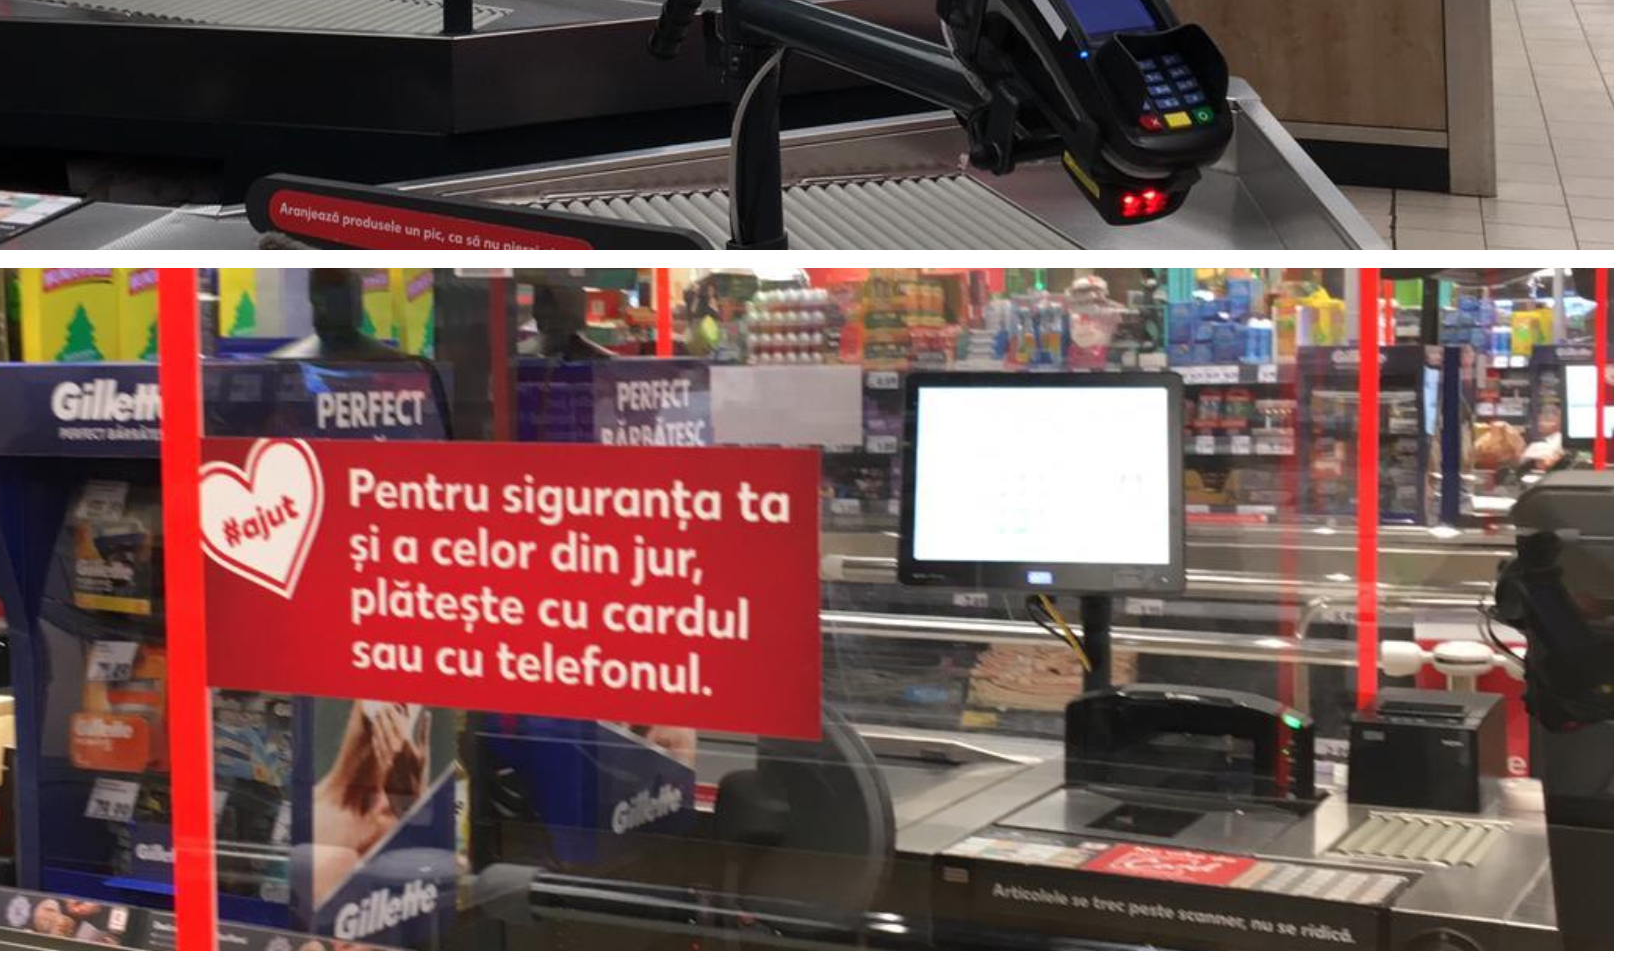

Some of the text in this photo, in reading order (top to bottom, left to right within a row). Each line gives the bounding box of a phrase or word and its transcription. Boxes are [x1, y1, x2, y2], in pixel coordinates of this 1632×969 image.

[279, 201, 341, 226] Aranjează
[342, 214, 403, 235] produsele
[405, 224, 421, 237] un
[423, 226, 445, 244] pic,
[448, 231, 464, 246] ca
[466, 232, 481, 248] să
[316, 389, 426, 430] PERFECT
[618, 379, 692, 411] PERFECT
[221, 494, 300, 548] #ajut
[348, 467, 791, 530] Pentru siguranța ta
[348, 529, 702, 587] și a celor din jur,
[349, 577, 749, 641] plătește cu cardul
[351, 639, 713, 697] sau cu telefonul.
[611, 780, 683, 836] Gillette
[334, 878, 439, 942] Gillette
[992, 882, 1068, 907] Articolele
[1072, 894, 1089, 909] se
[1093, 894, 1125, 913] trec
[1128, 901, 1174, 920] peste
[1251, 916, 1273, 933] nu
[1276, 920, 1298, 936] se
